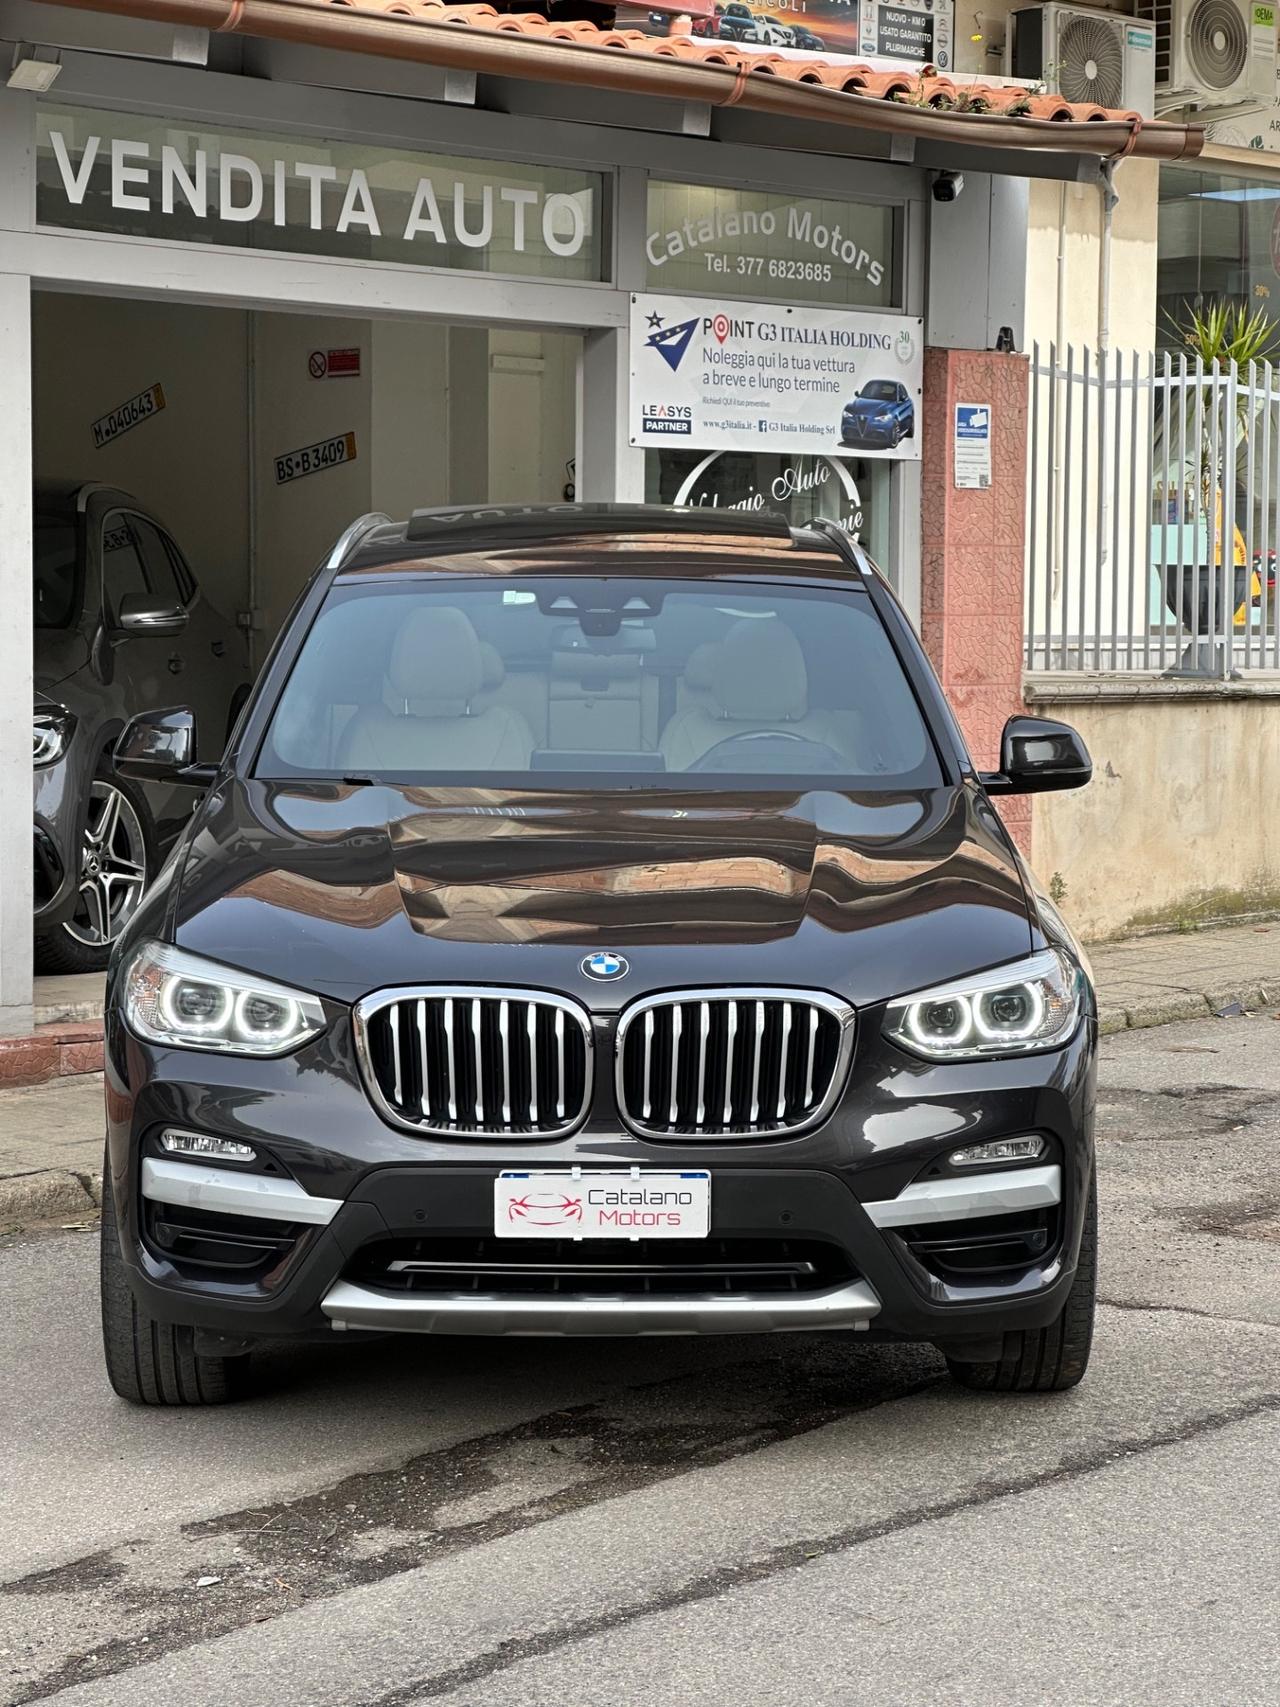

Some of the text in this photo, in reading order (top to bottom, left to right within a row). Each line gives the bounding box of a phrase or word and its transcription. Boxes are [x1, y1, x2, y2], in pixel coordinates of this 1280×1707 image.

[886, 11, 907, 23] NUOVO
[880, 25, 932, 43] USATO GARANTITO
[49, 131, 585, 257] VENDITA AUTO
[646, 207, 884, 286] Catalano Motors
[704, 252, 832, 282] Tel. 377 6823685
[757, 323, 777, 341] G3
[781, 327, 830, 345] ITALIA
[830, 330, 891, 350] HOLDING
[703, 347, 855, 373] Noleggia qui la tua vettura
[703, 370, 840, 393] a breve e lungo termine
[643, 404, 692, 418] LEASYS
[646, 420, 688, 432] PARTNER
[769, 423, 779, 431] G3
[780, 423, 798, 432] Italia
[799, 424, 824, 435] Holding
[588, 1189, 693, 1205] Catalano
[599, 1210, 681, 1226] Motors
